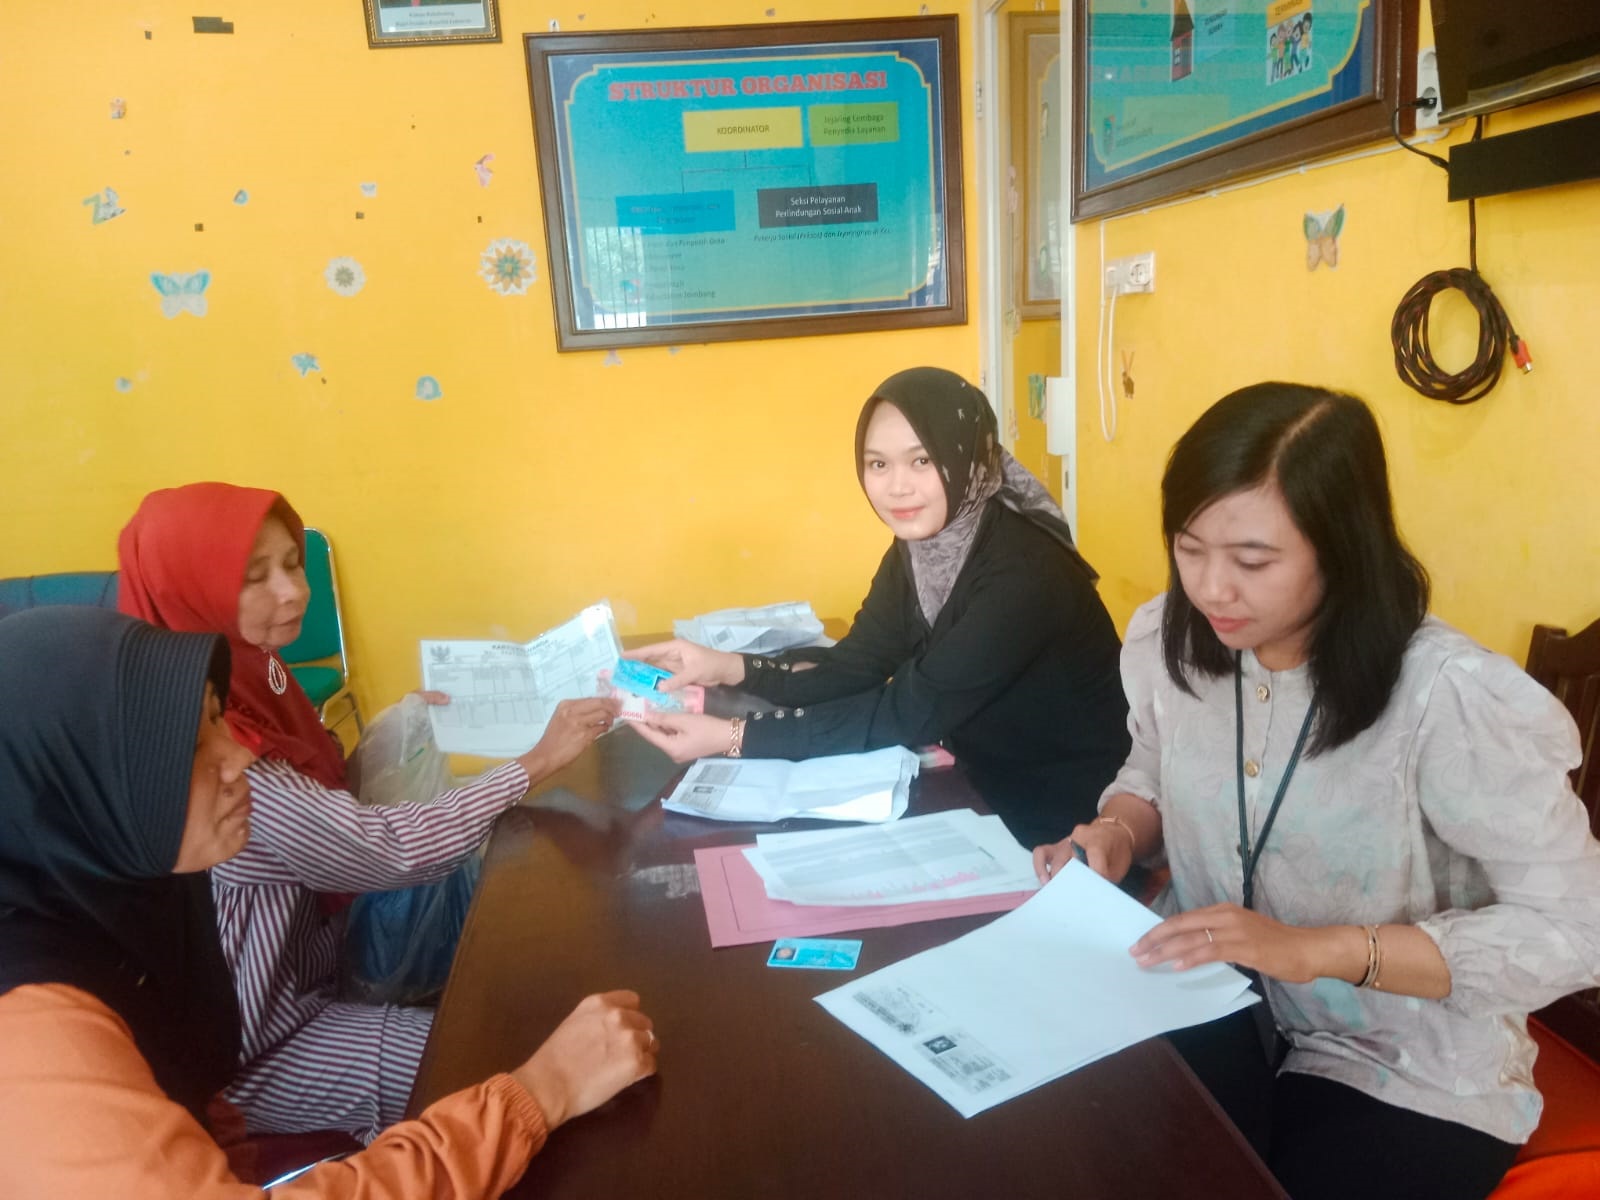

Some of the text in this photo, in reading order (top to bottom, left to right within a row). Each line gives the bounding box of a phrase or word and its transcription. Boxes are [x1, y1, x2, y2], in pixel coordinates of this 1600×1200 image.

[608, 70, 888, 101] STRUKTUR ORGANISASI
[716, 124, 769, 135] KOORDINATOR
[790, 195, 846, 206] Seksi Pelayanan
[775, 205, 862, 218] Perlindungan Sosial Anak
